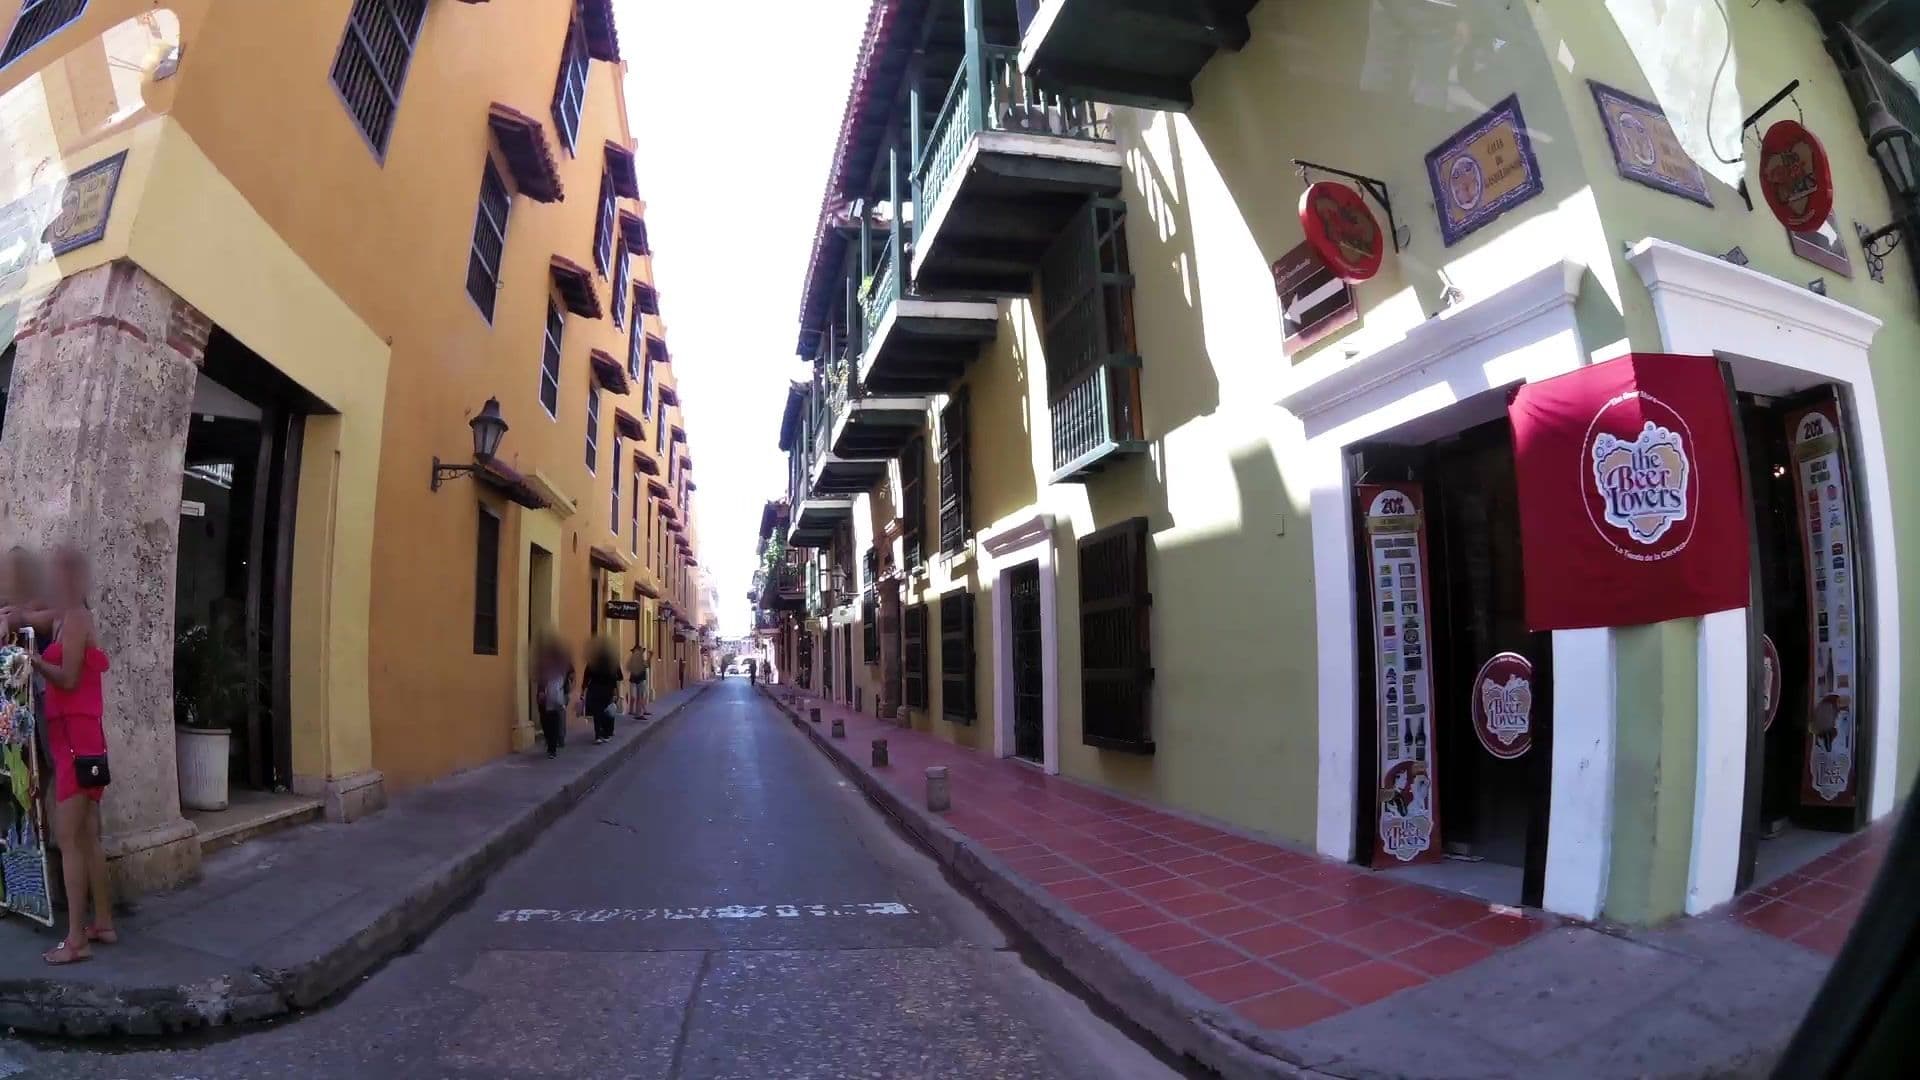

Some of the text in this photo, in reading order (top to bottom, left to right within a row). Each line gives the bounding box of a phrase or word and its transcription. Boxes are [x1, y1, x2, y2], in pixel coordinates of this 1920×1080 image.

[1631, 447, 1661, 472] the
[1606, 465, 1670, 492] Beer
[1607, 487, 1682, 517] Lovers
